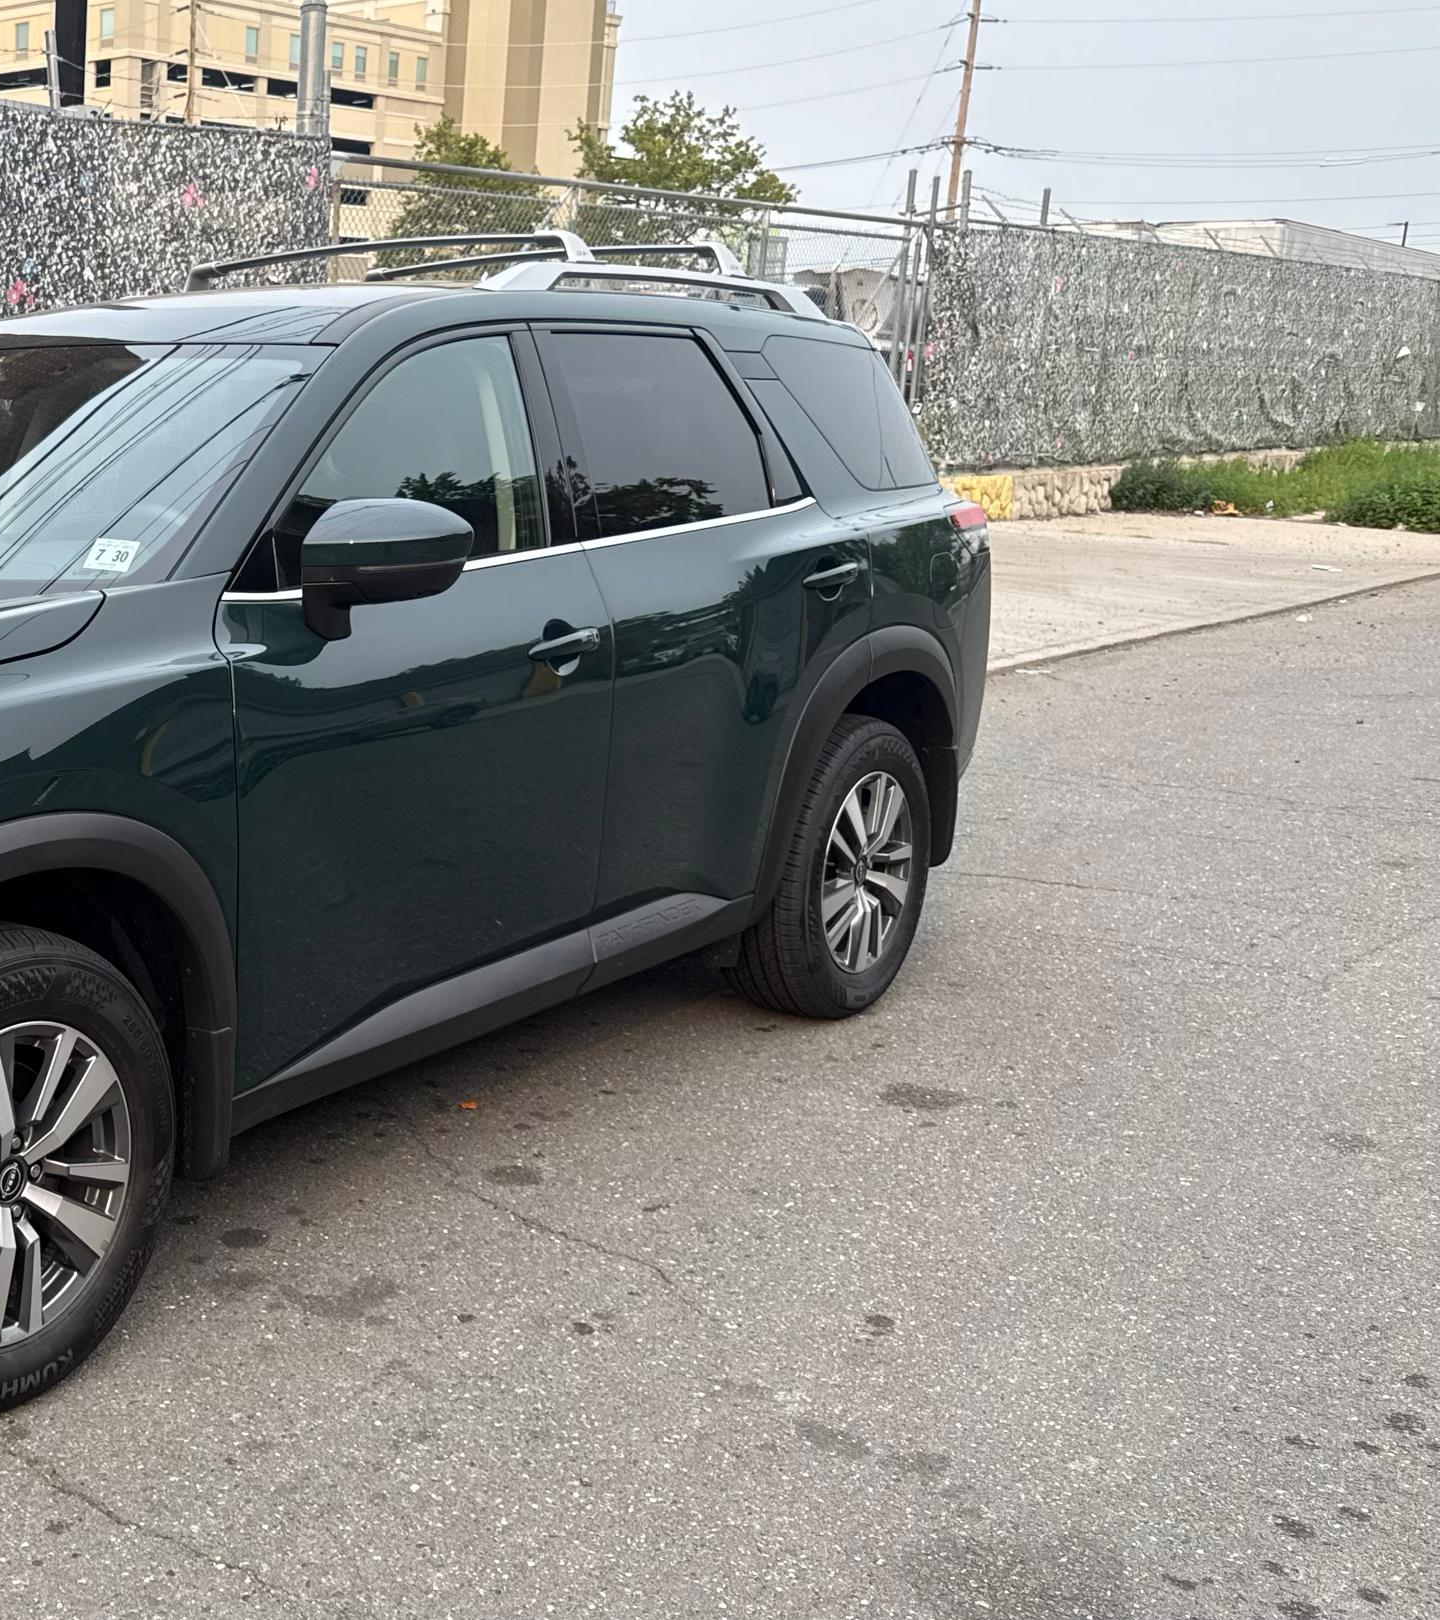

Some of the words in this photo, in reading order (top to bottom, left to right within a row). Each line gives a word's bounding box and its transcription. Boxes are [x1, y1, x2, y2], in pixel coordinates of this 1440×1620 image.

[95, 548, 106, 561] 7
[112, 550, 130, 563] 30
[597, 897, 701, 946] PATHFINDER
